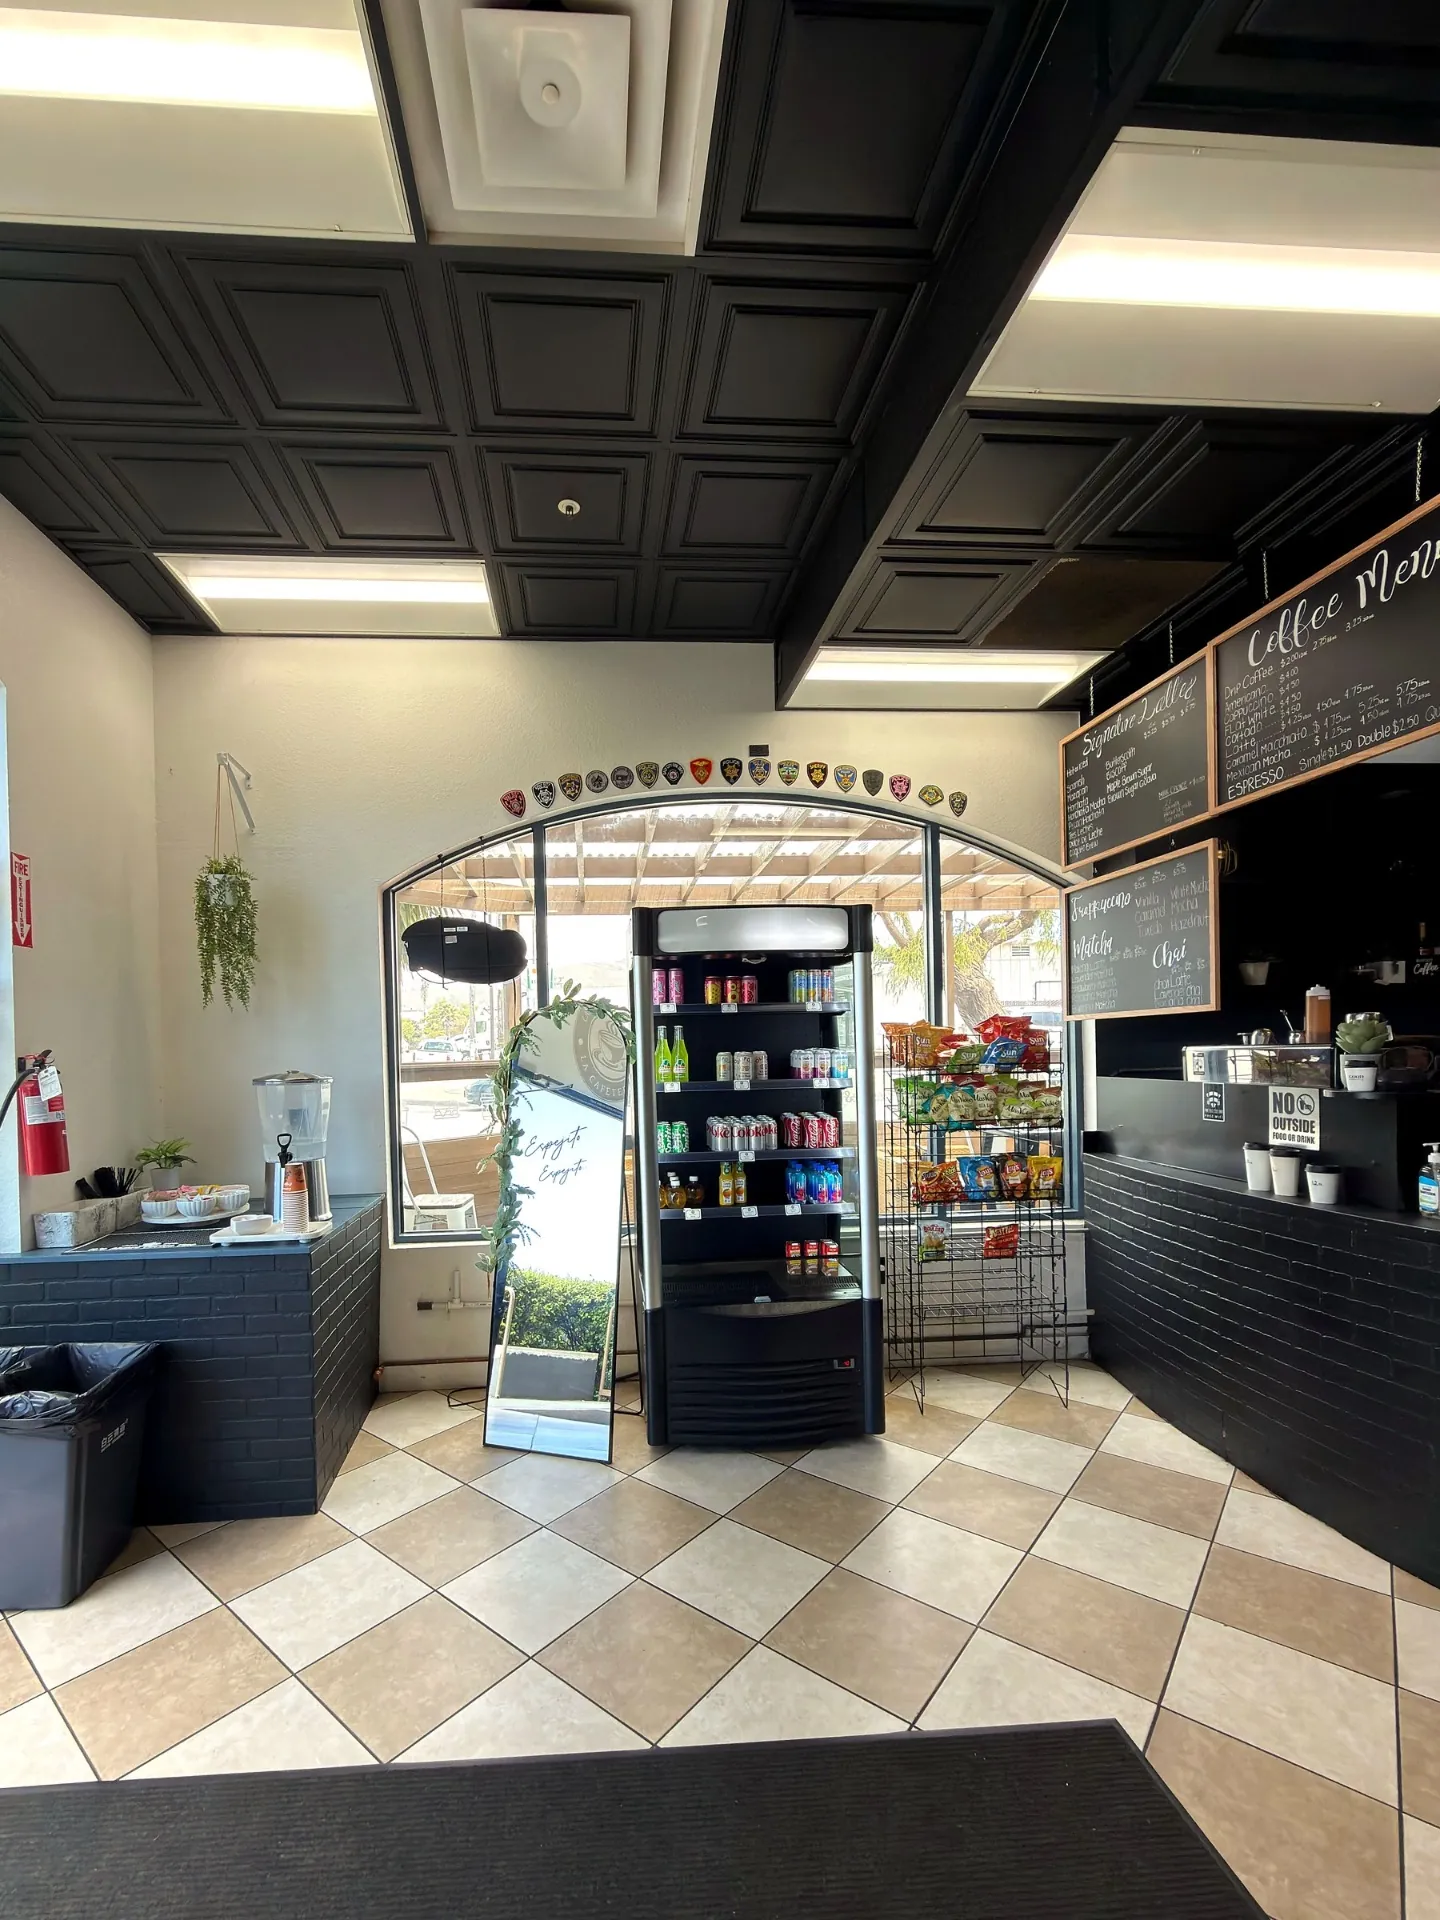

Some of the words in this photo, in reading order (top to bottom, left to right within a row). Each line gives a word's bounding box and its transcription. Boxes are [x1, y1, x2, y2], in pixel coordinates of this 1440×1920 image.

[1248, 593, 1343, 667] Coffee
[1242, 665, 1273, 689] Coffee
[1137, 762, 1153, 779] Sugar
[1227, 766, 1284, 800] ESPRESSO
[1299, 748, 1327, 771] Single
[1358, 725, 1391, 748] Double
[1227, 760, 1261, 783] Mexican
[1262, 748, 1291, 768] Mocha
[14, 861, 29, 876] FIRE
[1073, 930, 1113, 960] Matcha
[1152, 938, 1187, 969] Chai
[1413, 961, 1439, 977] Coffee
[916, 1036, 931, 1045] Sun
[1029, 1036, 1045, 1045] Sun
[961, 1052, 977, 1060] Sun
[1001, 1049, 1017, 1058] Sun
[589, 1075, 626, 1098] CAFETE
[1272, 1092, 1295, 1114] NO
[1272, 1116, 1316, 1134] OUTSIDE
[525, 1125, 588, 1160] Espejito
[1272, 1132, 1287, 1141] FOOD
[1288, 1133, 1296, 1142] OR
[1297, 1134, 1315, 1144] DRINK
